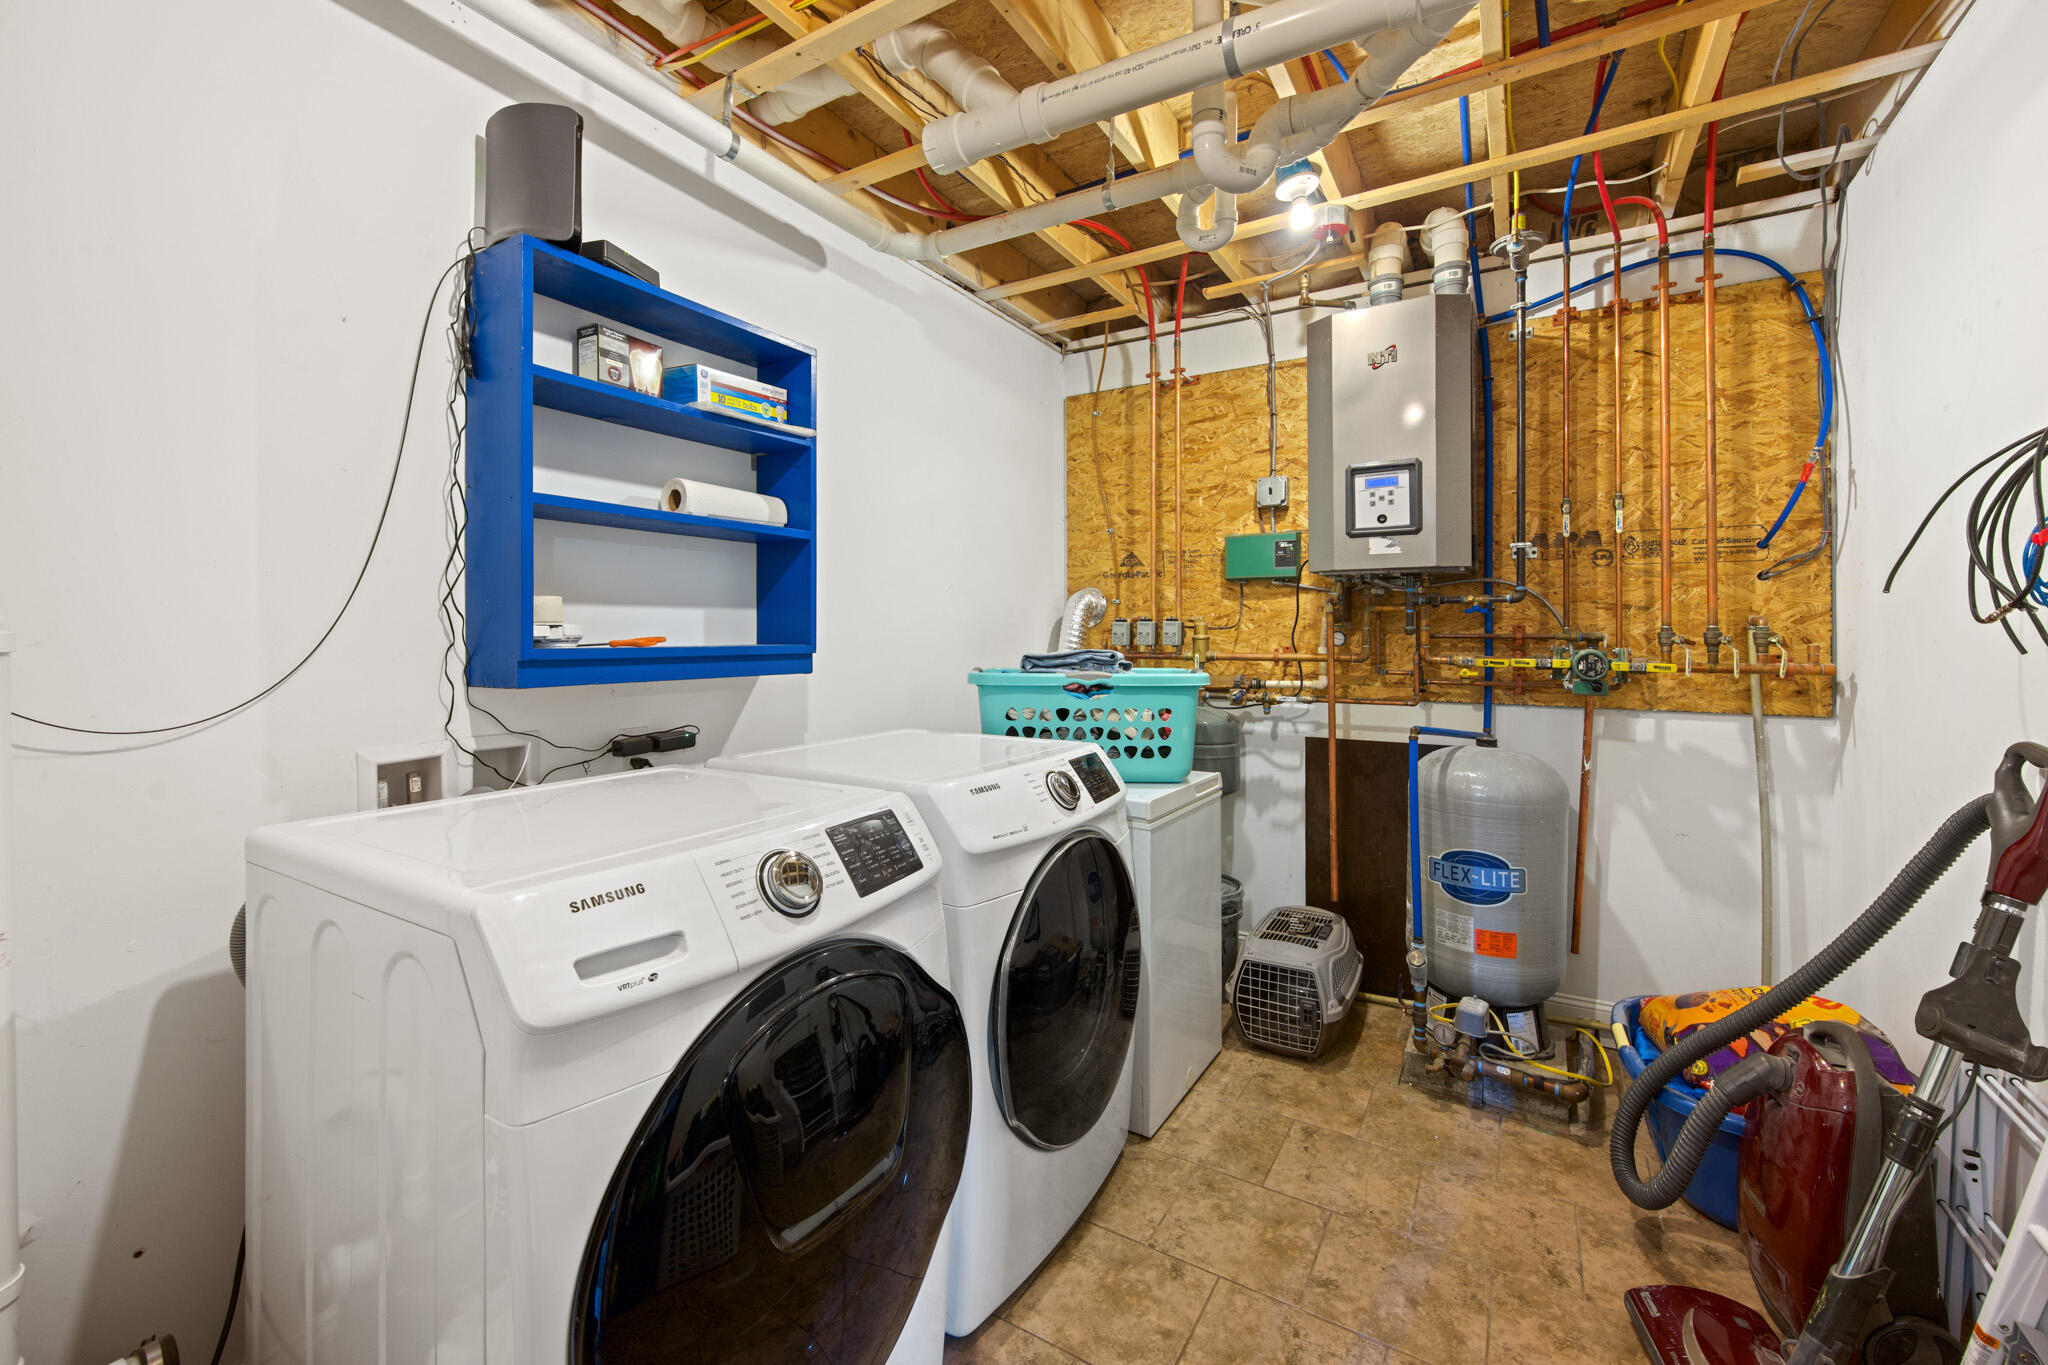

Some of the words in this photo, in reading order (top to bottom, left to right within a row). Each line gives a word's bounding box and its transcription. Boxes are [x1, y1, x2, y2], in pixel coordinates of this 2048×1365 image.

[1123, 66, 1132, 76] 40
[1132, 63, 1145, 73] SCH
[969, 782, 1002, 797] SAMSUNG
[569, 882, 646, 914] SAMSUNG
